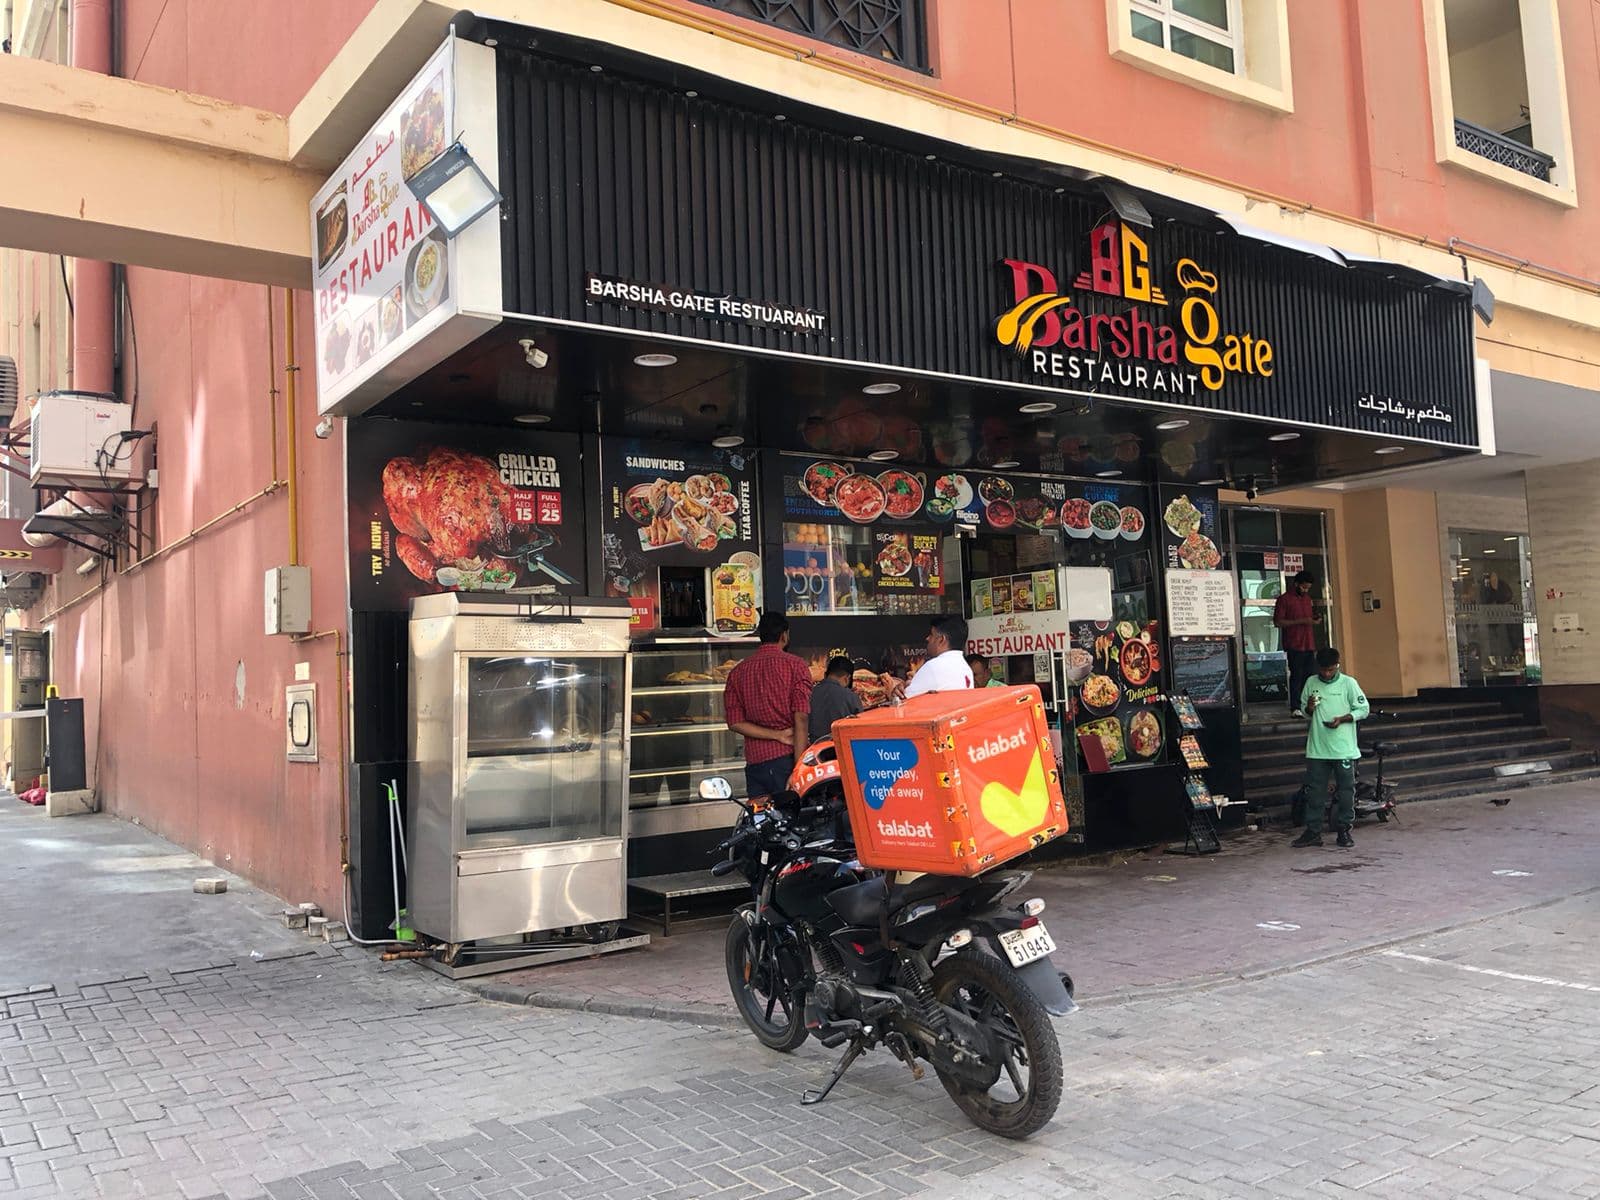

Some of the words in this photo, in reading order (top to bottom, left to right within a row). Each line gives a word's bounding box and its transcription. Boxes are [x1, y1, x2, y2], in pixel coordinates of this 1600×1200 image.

[352, 130, 394, 192] مطعم
[319, 200, 433, 326] RESTAURAN
[590, 278, 666, 306] BARSHA
[670, 291, 715, 313] GATE
[719, 299, 825, 330] RESTUARANT
[1003, 258, 1178, 365] Barsha
[1033, 350, 1198, 395] RESTAURANT
[1417, 405, 1452, 423] مطعم
[498, 453, 557, 472] GRILLED
[626, 456, 685, 472] SANDWICHES
[500, 468, 560, 488] CHICKEN
[515, 508, 532, 521] 15
[541, 508, 560, 522] 25
[370, 521, 382, 550] NOW!
[371, 554, 383, 576] TRY
[967, 632, 1066, 655] RESTAURANT
[877, 749, 900, 761] Your
[967, 727, 1027, 764] talabat
[794, 764, 836, 790] alaba
[869, 767, 919, 783] everyday,
[871, 786, 894, 801] right
[897, 789, 924, 800] away
[877, 819, 934, 839] talabat
[1012, 936, 1050, 962] 51943
